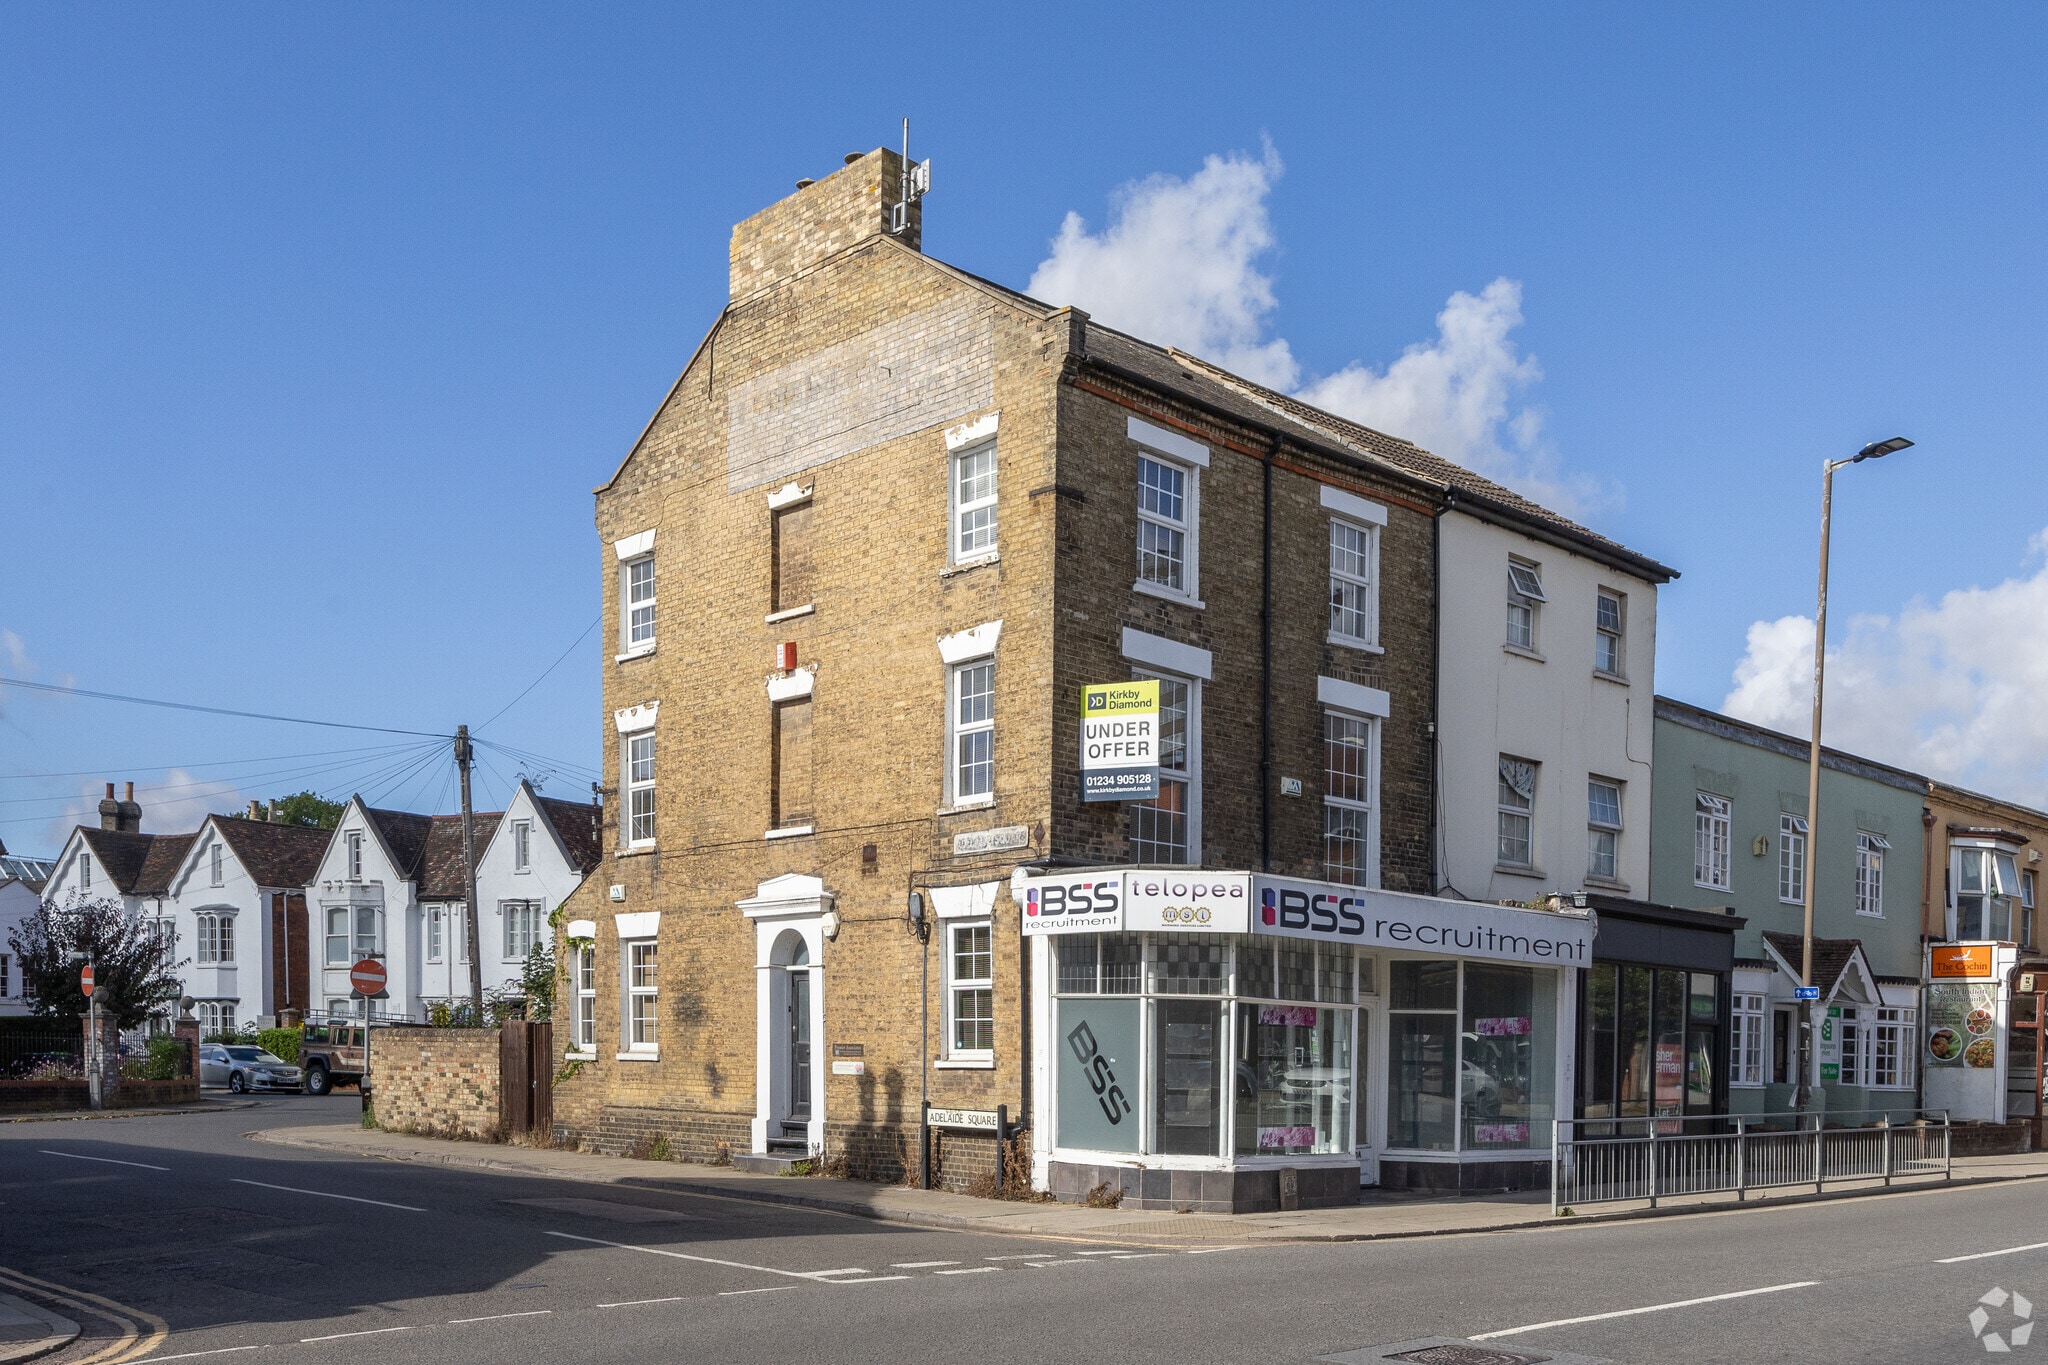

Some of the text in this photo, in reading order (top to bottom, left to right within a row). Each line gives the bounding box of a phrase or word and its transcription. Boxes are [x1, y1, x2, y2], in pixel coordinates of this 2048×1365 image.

[1109, 690, 1140, 700] Kirkby
[1109, 698, 1152, 710] Diamond
[1086, 721, 1150, 739] UNDER
[1088, 741, 1150, 759] OFFER
[1086, 774, 1152, 786] 01234 905128
[1086, 786, 1151, 794] www.kirkbydiamond.co.uk
[1132, 878, 1243, 902] telopea
[1025, 916, 1117, 929] recruitment
[1375, 919, 1586, 961] recruitment
[1935, 961, 1988, 971] The Cochin
[1934, 987, 1988, 995] South Indian
[1940, 995, 1981, 1003] Restaurant
[1656, 1048, 1674, 1062] sher
[1067, 1020, 1131, 1125] BSS
[1656, 1062, 1681, 1074] erman
[929, 1112, 997, 1126] ADELAIDE SQUARE
